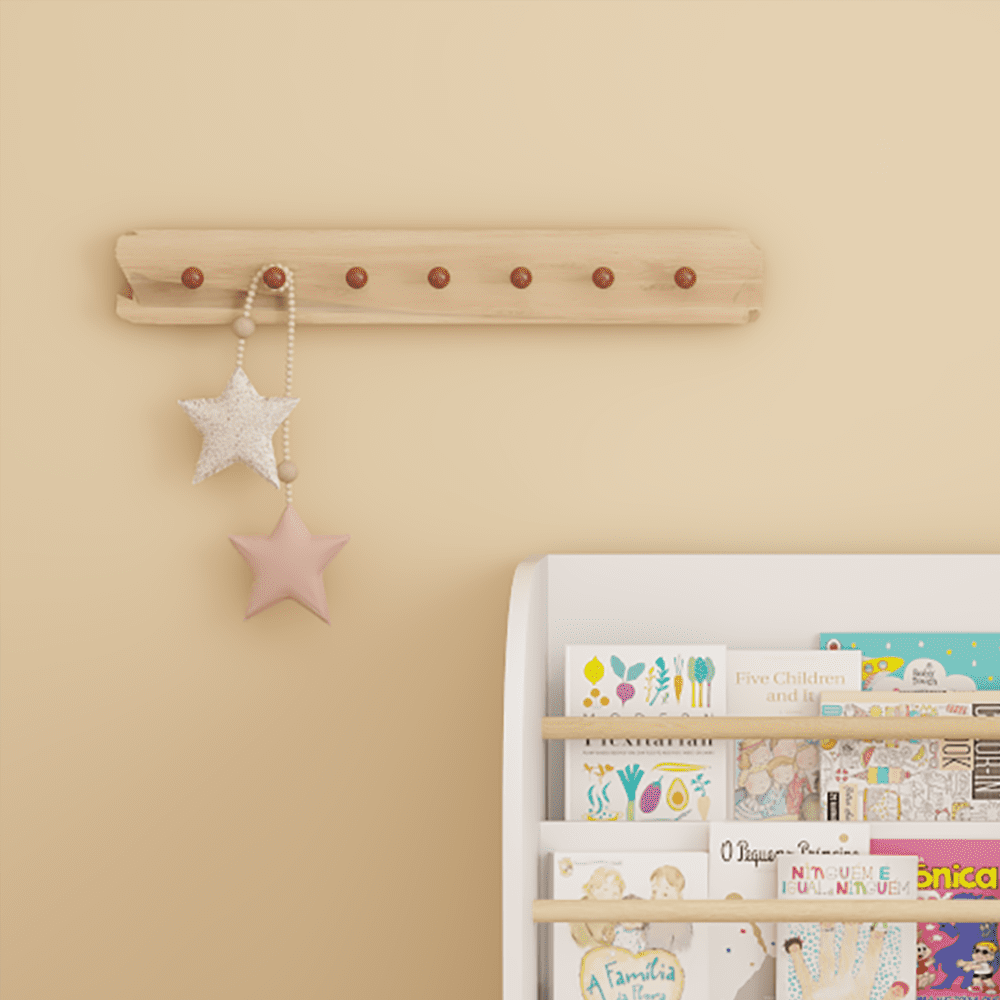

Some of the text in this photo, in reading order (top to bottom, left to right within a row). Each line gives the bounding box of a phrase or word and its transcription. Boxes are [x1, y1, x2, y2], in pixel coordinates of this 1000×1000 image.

[735, 670, 846, 685] Five Children
[766, 688, 799, 702] and
[720, 839, 734, 863] O
[918, 862, 999, 890] ônica
